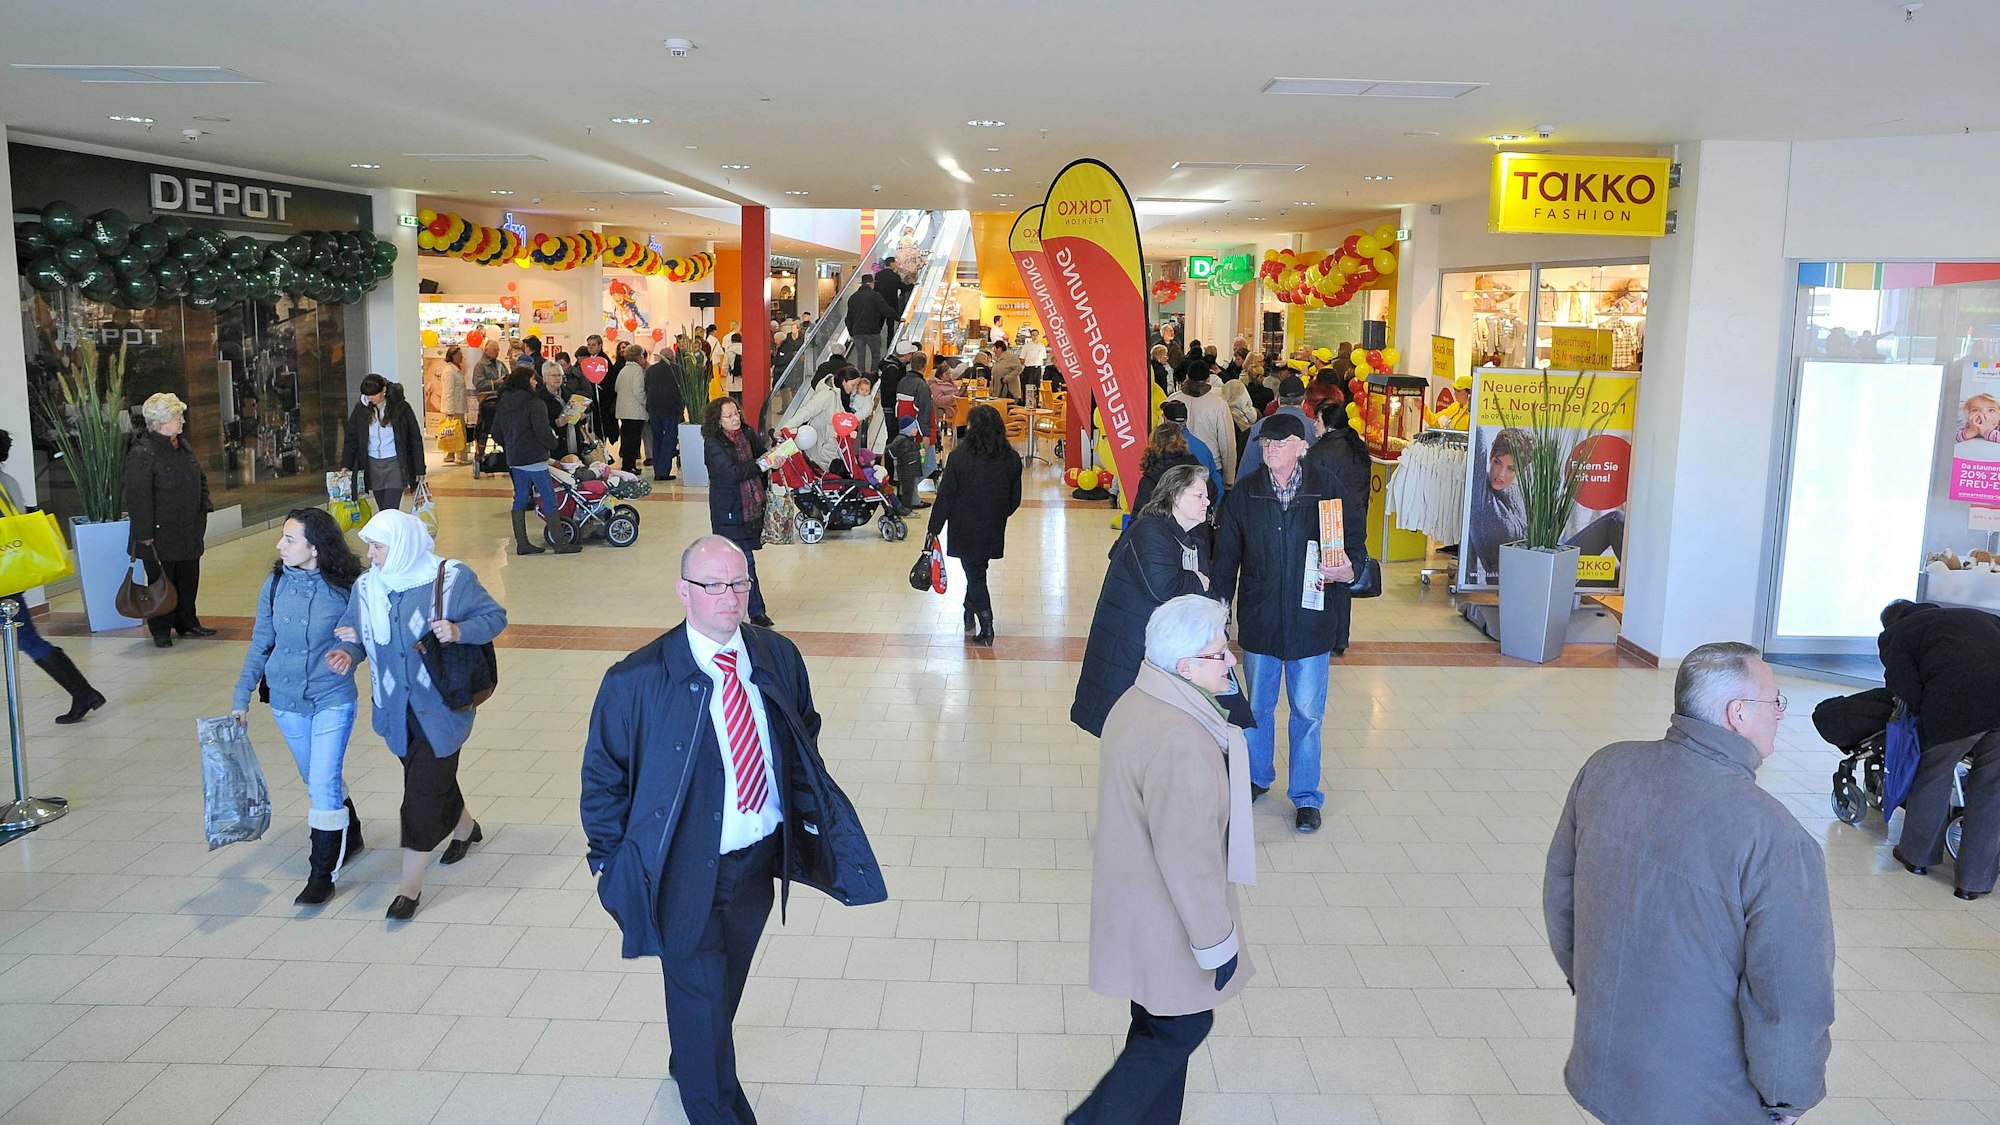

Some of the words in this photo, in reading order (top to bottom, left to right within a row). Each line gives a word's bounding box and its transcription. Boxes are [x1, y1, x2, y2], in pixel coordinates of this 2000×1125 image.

[149, 172, 292, 221] DEPOT
[1534, 208, 1631, 221] FASHION
[1603, 461, 1619, 471] Sie
[1590, 473, 1611, 482] uns!
[1960, 470, 1987, 480] 20%
